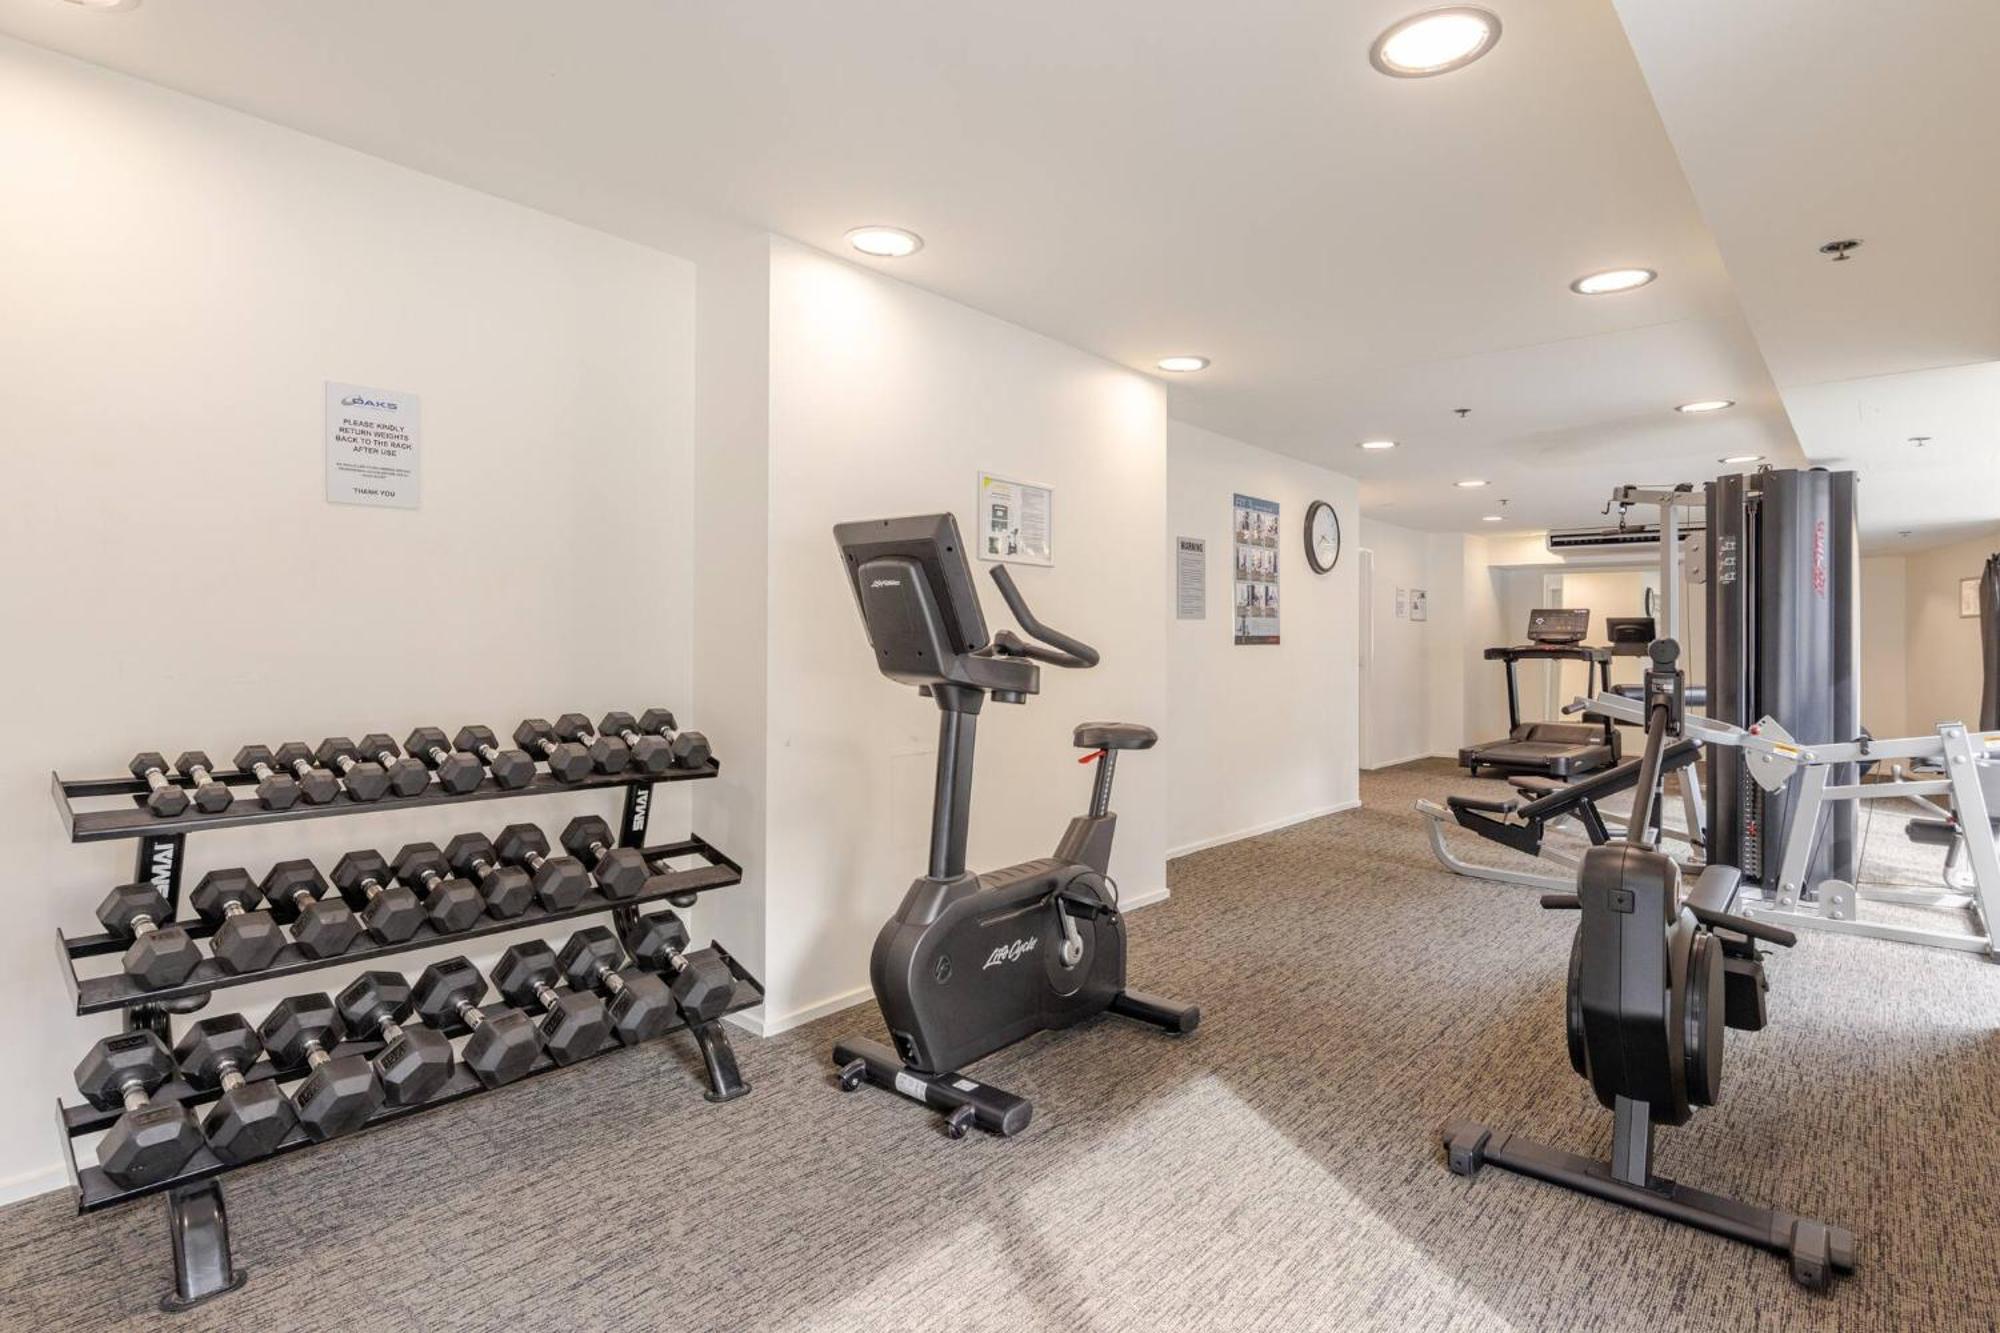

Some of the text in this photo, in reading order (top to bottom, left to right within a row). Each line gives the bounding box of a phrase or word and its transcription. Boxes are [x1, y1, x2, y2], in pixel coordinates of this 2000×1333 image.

[352, 396, 398, 410] OAKS
[343, 418, 405, 433] PLEASE KINDLY
[339, 427, 409, 441] RETURN WEIGHTS
[335, 434, 412, 451] BACK TO THE RACK
[353, 446, 397, 457] AFTER USE
[353, 487, 396, 497] THANK YOU
[1180, 541, 1203, 552] WARNING
[632, 789, 649, 831] SMAI
